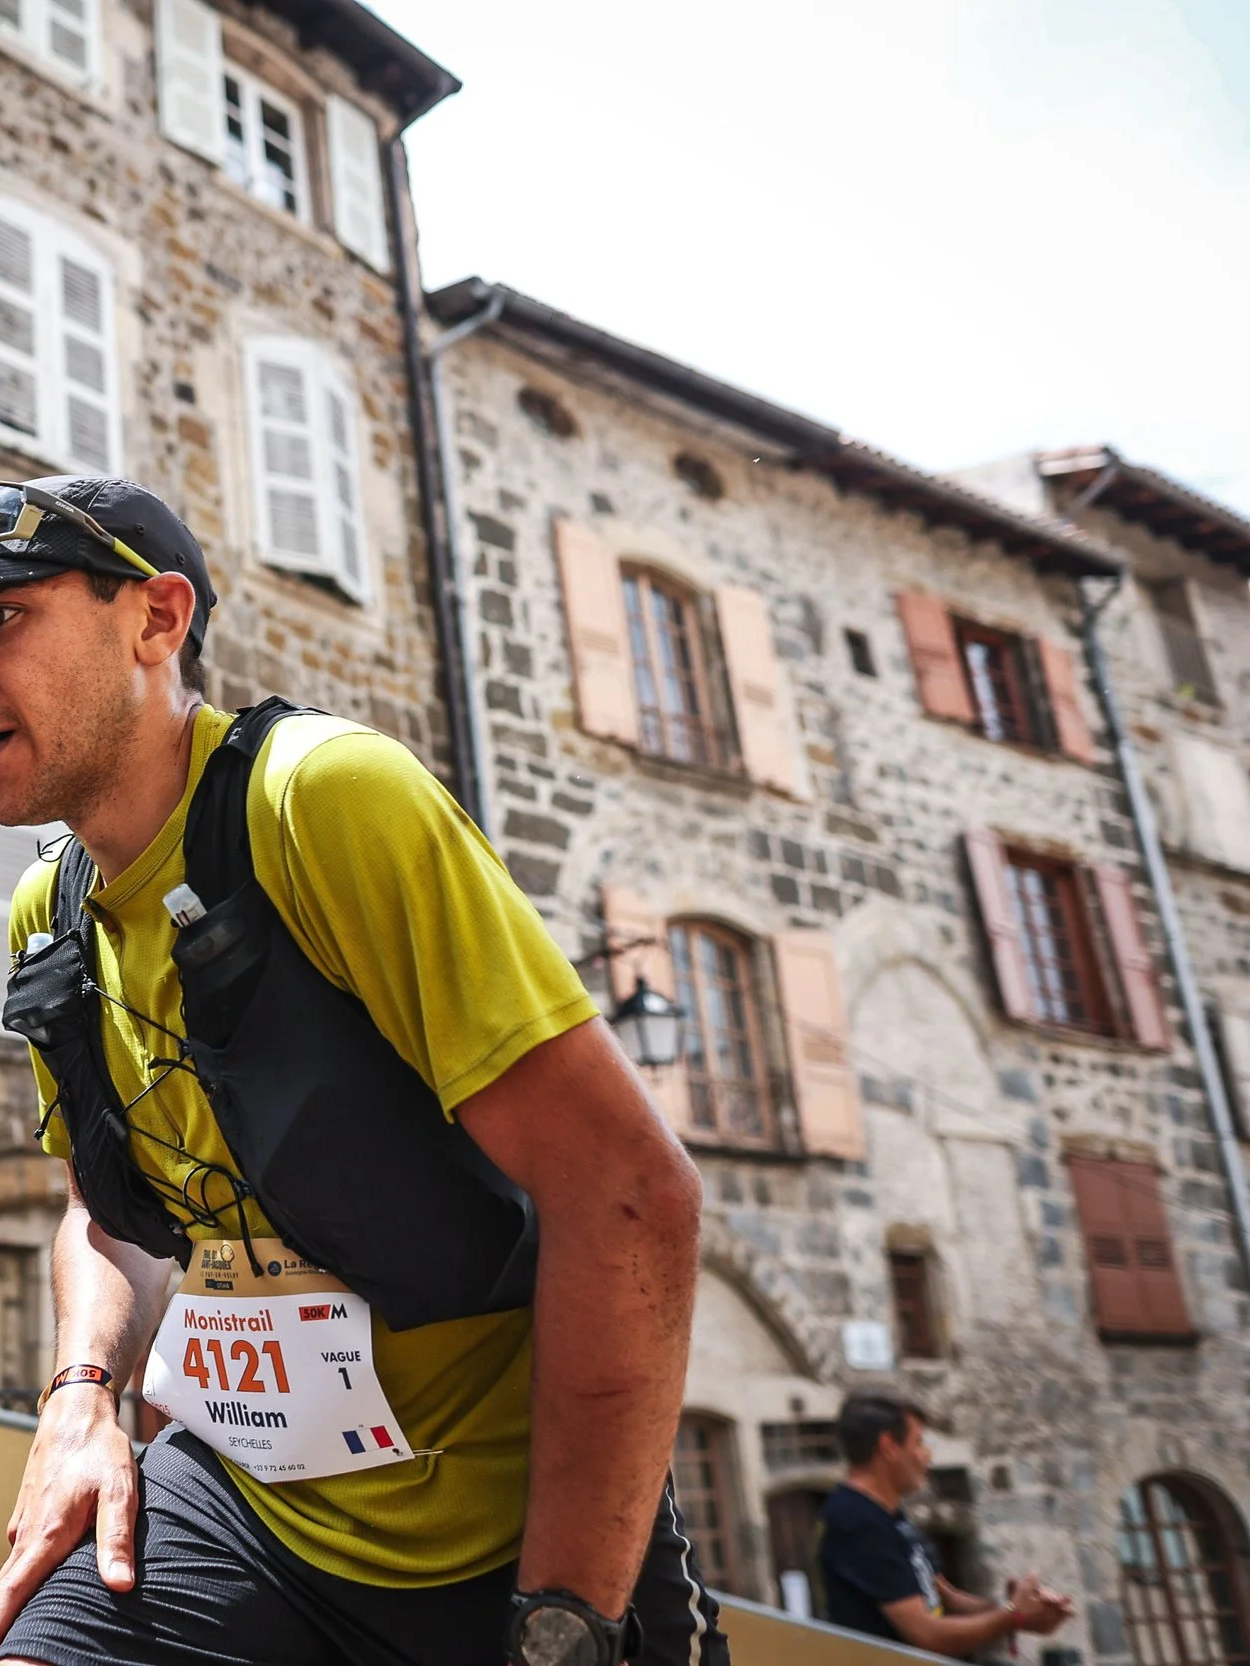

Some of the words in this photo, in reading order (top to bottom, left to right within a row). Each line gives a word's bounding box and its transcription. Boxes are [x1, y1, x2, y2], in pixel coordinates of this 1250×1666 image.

[184, 1308, 274, 1332] Monistrail
[303, 1307, 327, 1318] 50K
[330, 1303, 348, 1319] M
[183, 1337, 290, 1393] 4121
[320, 1350, 361, 1362] VAGUE
[338, 1367, 352, 1390] 1
[205, 1400, 288, 1428] William
[228, 1436, 273, 1450] SEYCHELLES
